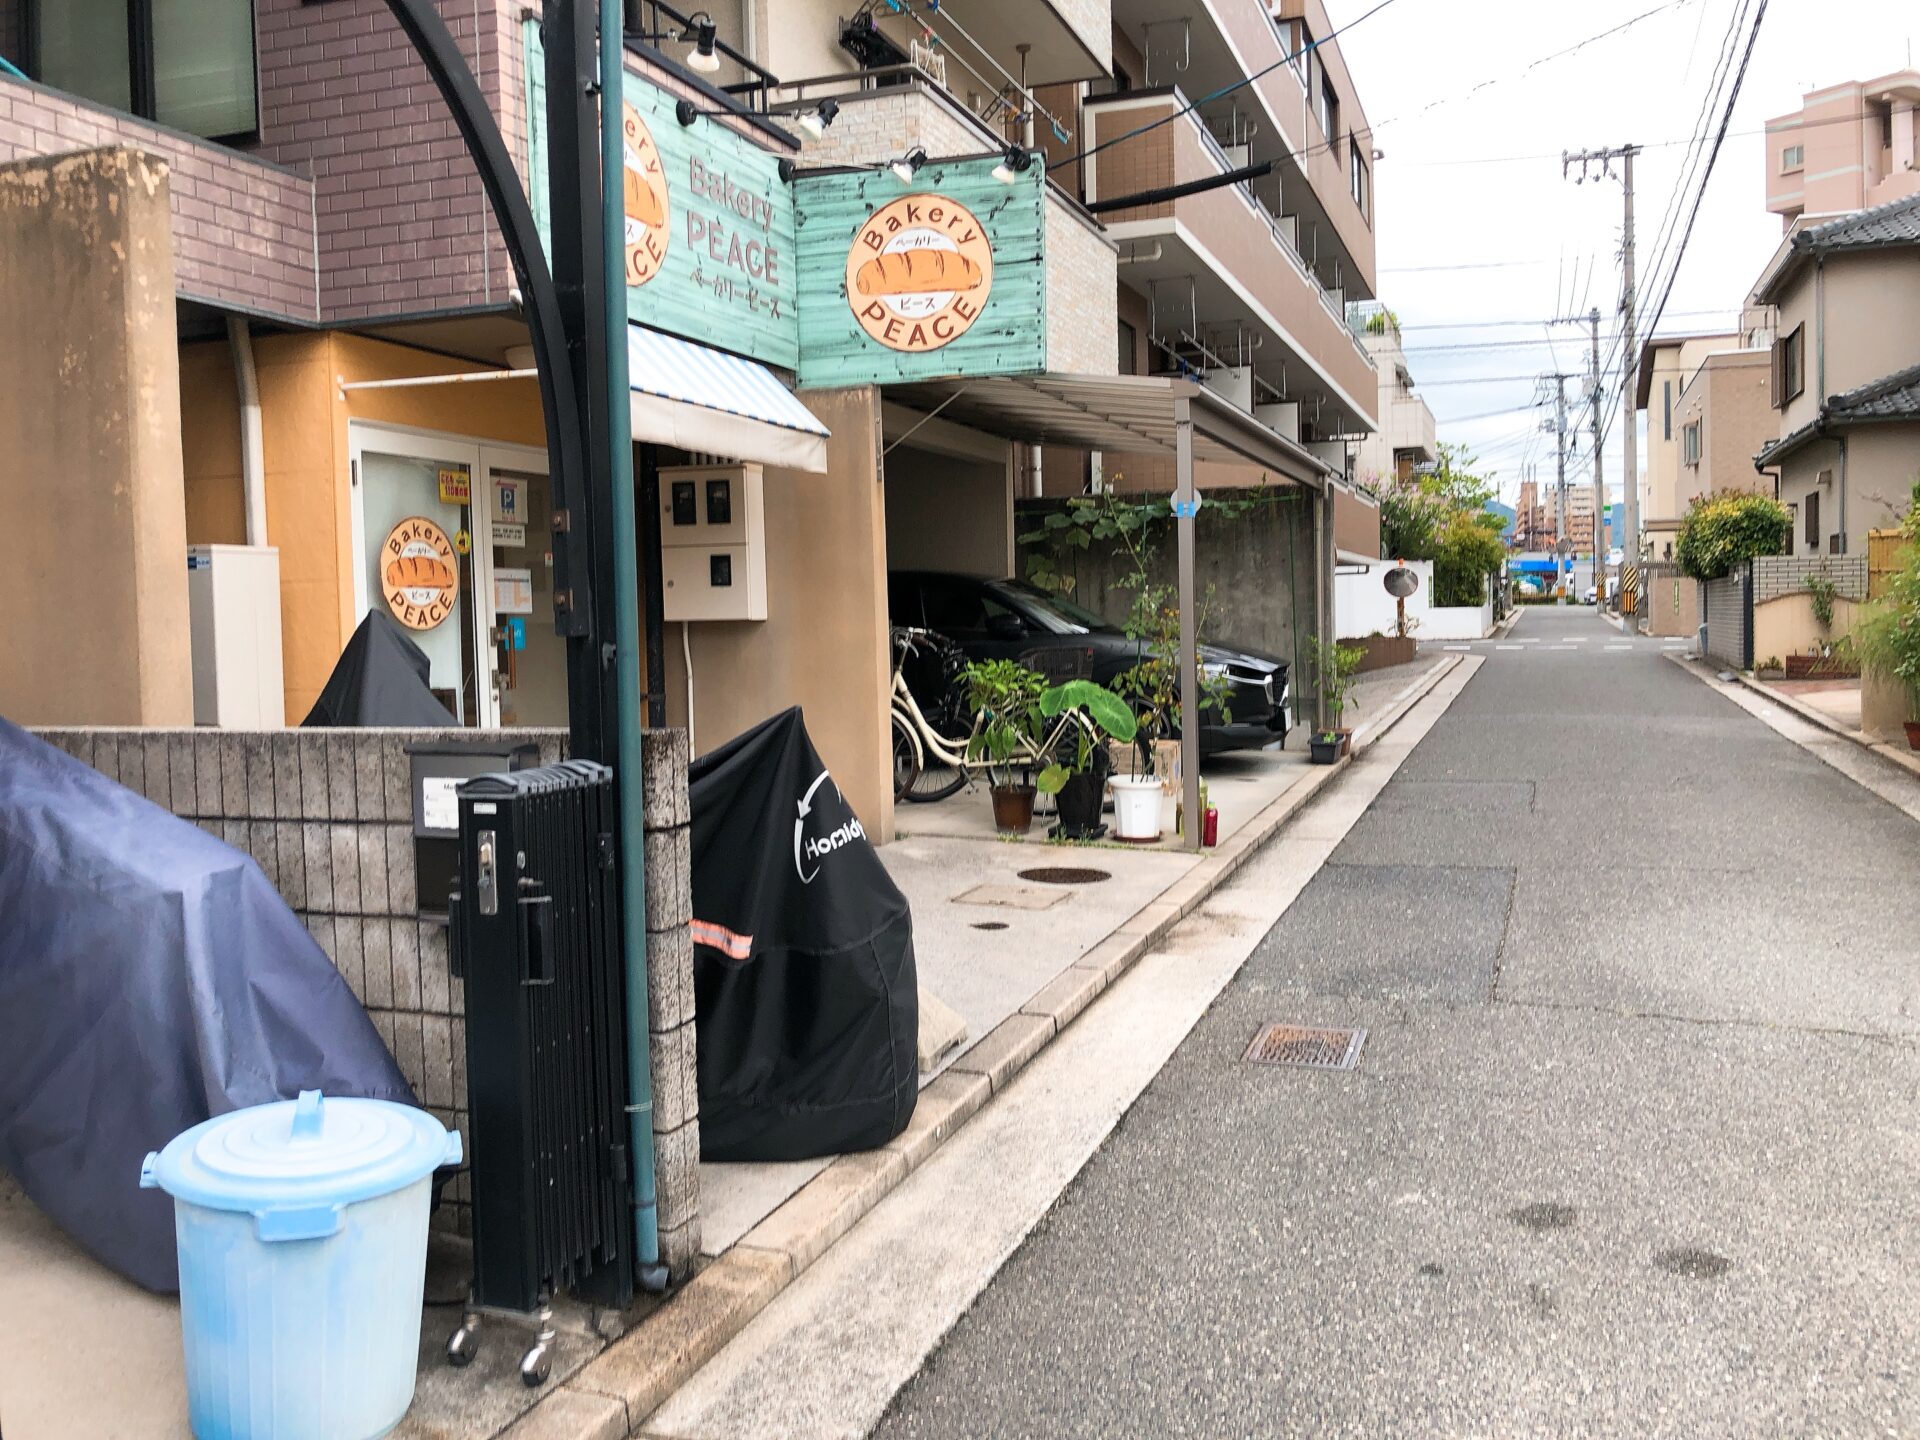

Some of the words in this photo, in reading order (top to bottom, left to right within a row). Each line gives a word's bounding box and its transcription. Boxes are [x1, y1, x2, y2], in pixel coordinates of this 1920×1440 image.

[690, 155, 773, 234] Bakery
[686, 209, 779, 286] PEACE
[862, 203, 977, 252] Bakery
[860, 296, 978, 347] PEACE
[389, 521, 450, 556] Bakery
[390, 591, 452, 627] PEACE
